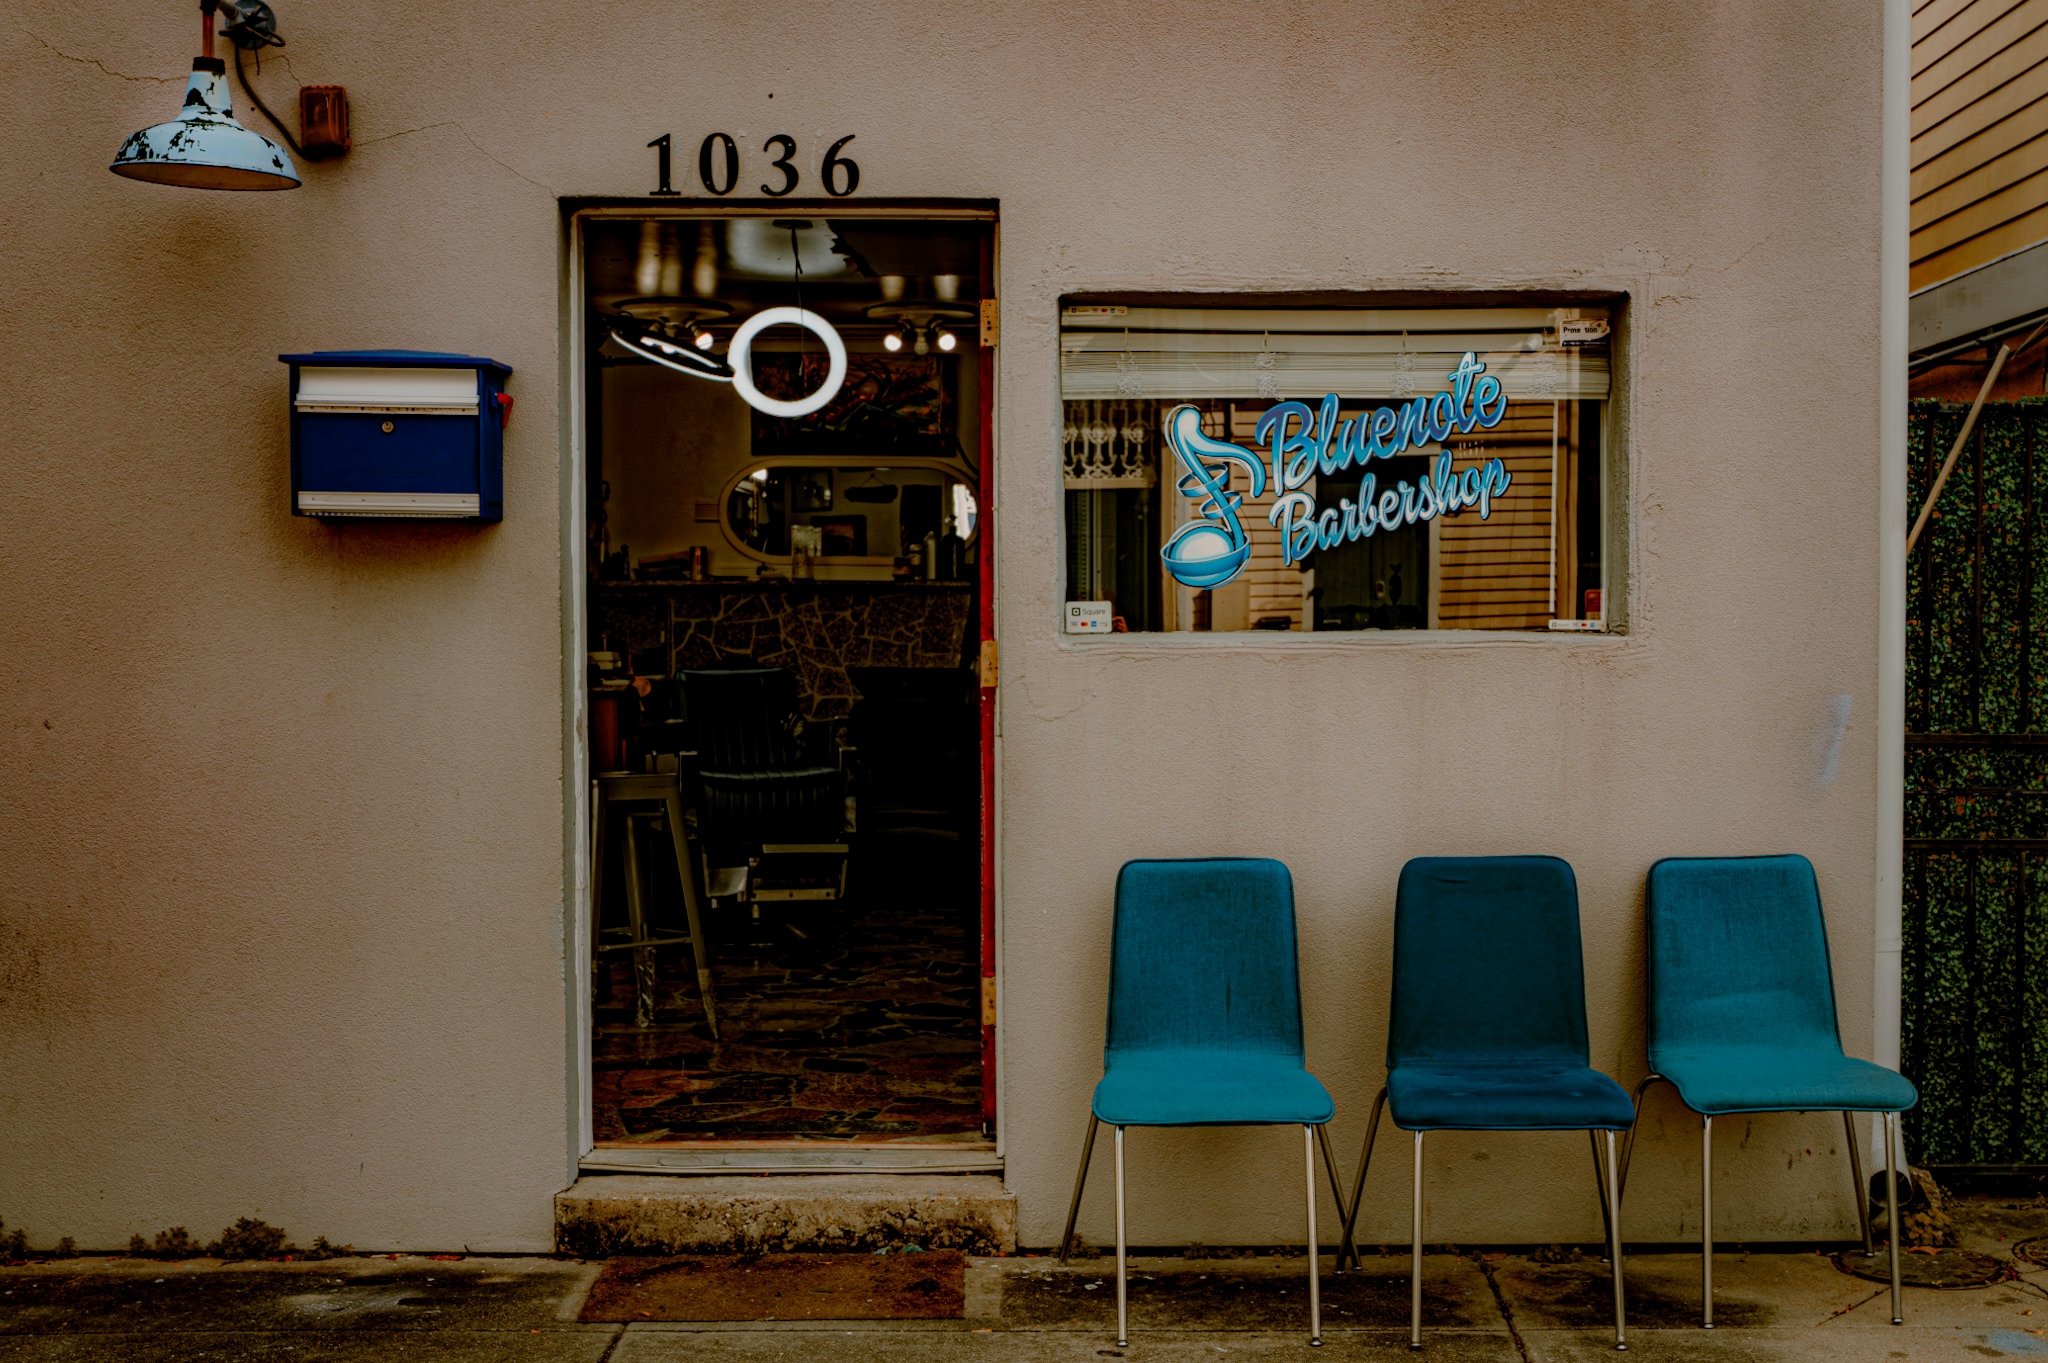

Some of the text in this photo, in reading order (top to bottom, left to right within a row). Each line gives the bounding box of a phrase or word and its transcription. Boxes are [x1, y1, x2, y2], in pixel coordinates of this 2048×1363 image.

[646, 132, 861, 197] 1036
[1254, 350, 1509, 499] Bluenote
[1267, 448, 1513, 568] Barbershop
